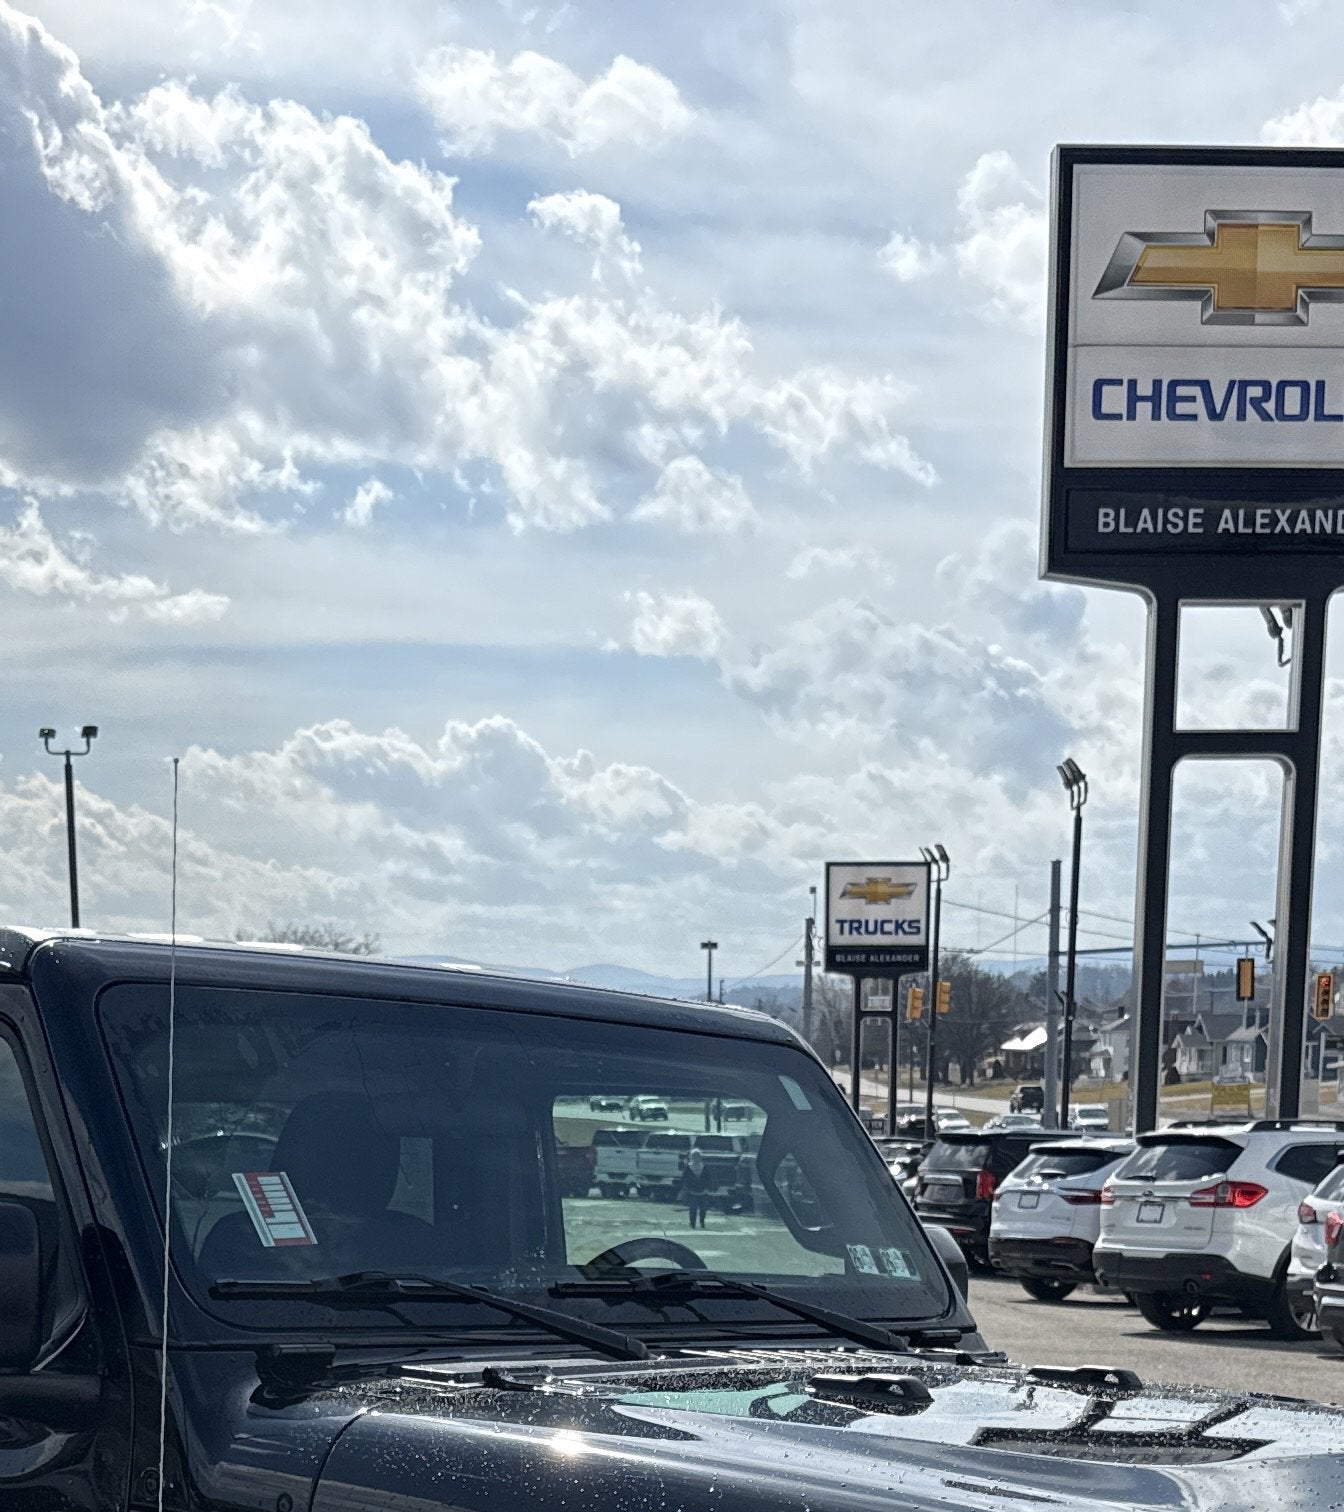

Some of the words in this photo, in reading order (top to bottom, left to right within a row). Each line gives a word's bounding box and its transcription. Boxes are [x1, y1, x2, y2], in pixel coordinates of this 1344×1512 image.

[1097, 507, 1205, 534] BLAISE
[835, 919, 921, 936] TRUCKS
[835, 954, 867, 963] BLAISE
[869, 954, 920, 963] ALEXANDER
